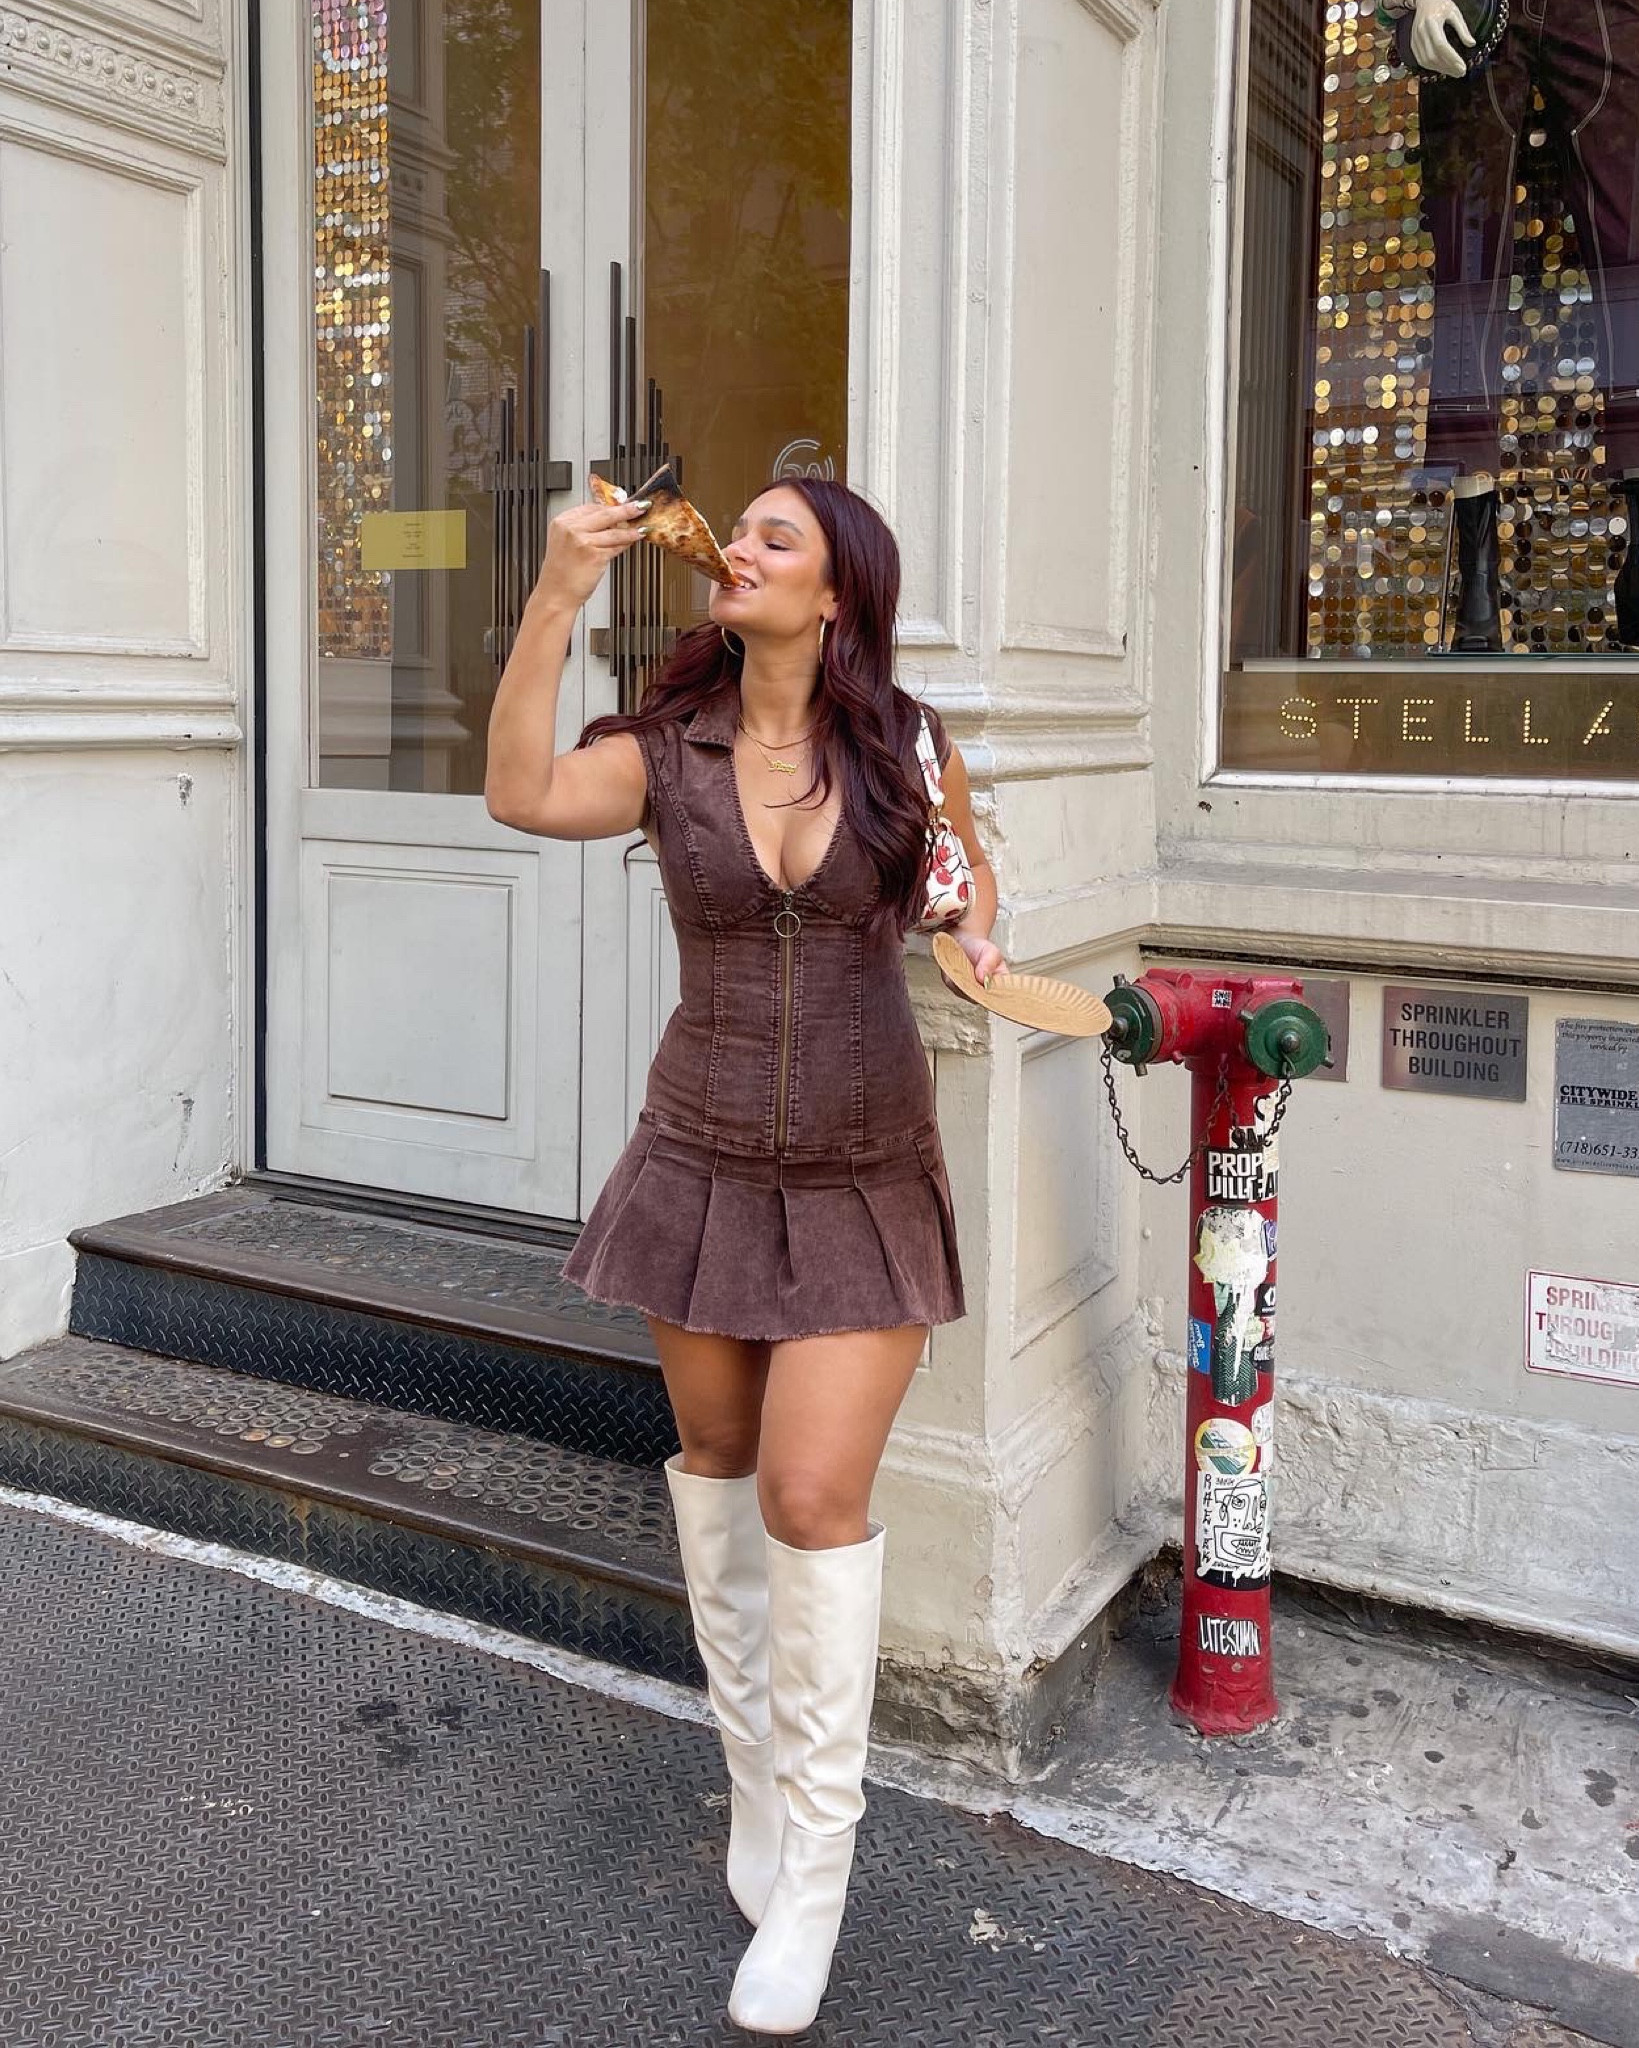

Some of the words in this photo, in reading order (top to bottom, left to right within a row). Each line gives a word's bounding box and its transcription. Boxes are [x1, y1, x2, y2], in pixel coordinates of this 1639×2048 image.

[1280, 695, 1613, 743] STELLA
[1400, 1002, 1510, 1030] SPRINKLER
[1389, 1028, 1521, 1058] THROUGHOUT
[1408, 1056, 1499, 1083] BUILDING
[1559, 1084, 1639, 1101] CITYWIDE
[1560, 1096, 1586, 1106] FIRE
[1559, 1141, 1639, 1160] (718)651-33
